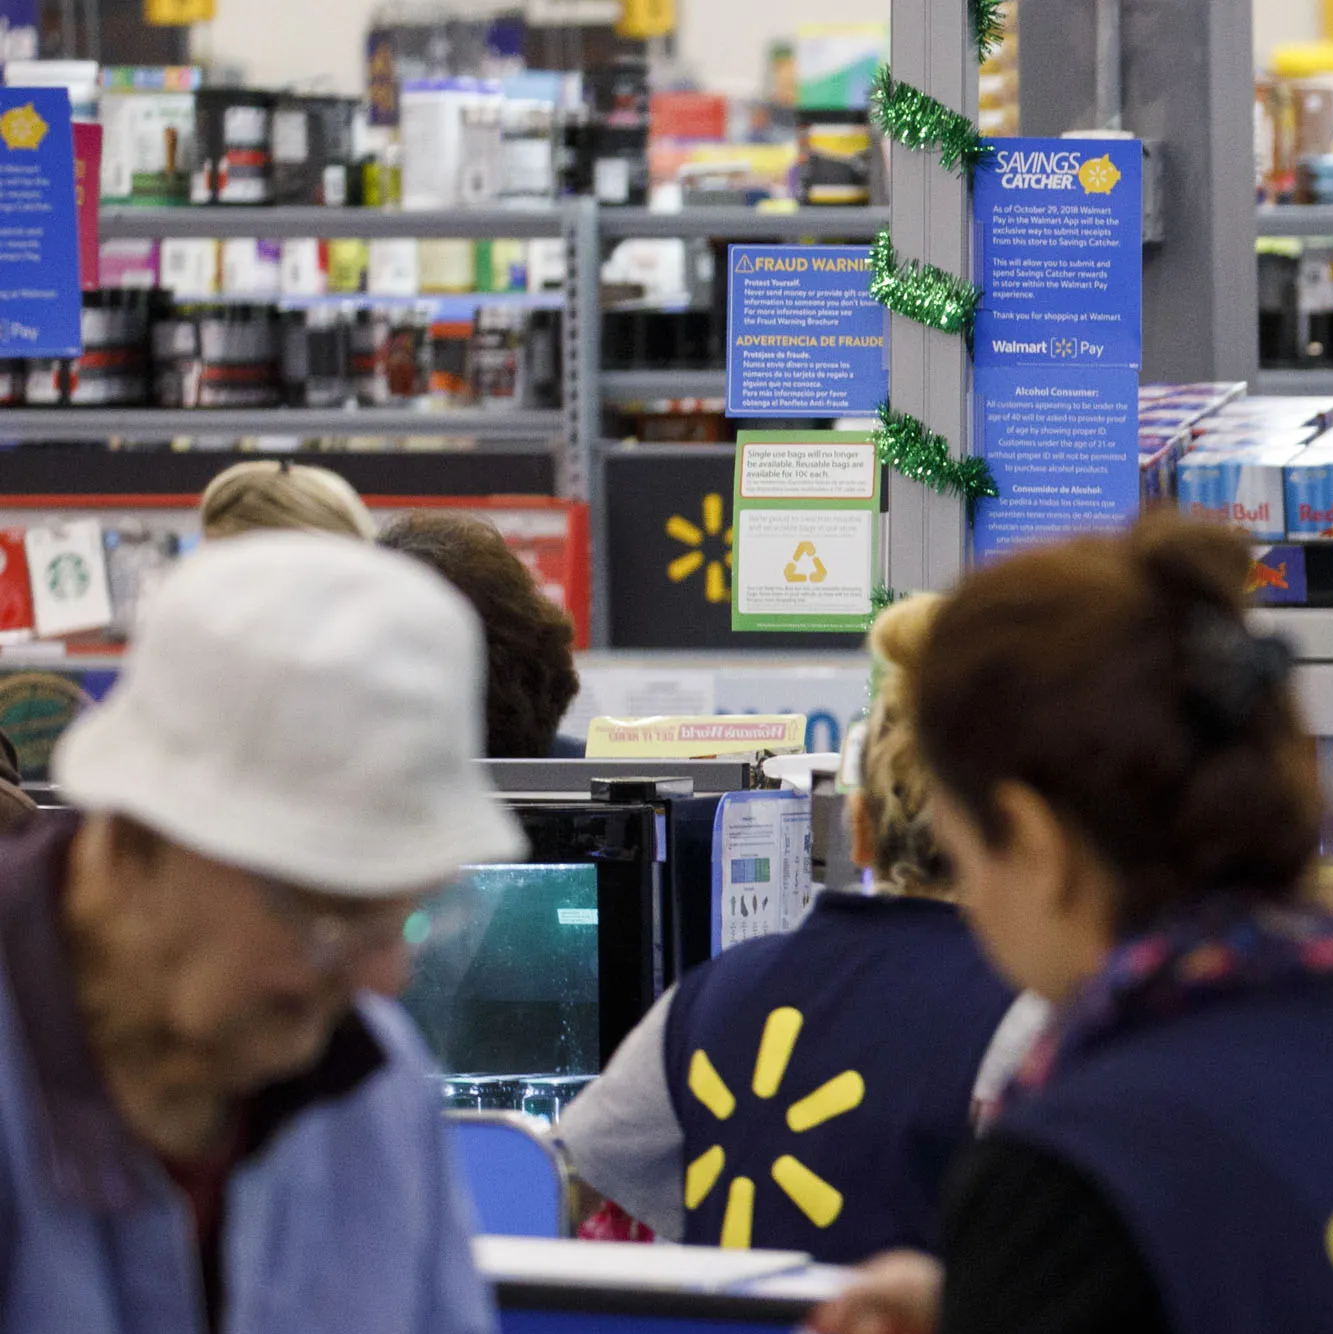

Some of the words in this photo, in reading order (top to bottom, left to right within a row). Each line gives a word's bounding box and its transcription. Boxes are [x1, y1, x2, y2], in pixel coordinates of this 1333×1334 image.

[995, 151, 1080, 174] SAVINGS
[1002, 174, 1073, 189] CATCHER
[993, 205, 1002, 213] As
[1004, 205, 1013, 213] of
[1014, 205, 1045, 213] October
[1048, 206, 1059, 215] 29,
[1080, 207, 1111, 215] Walmart
[993, 216, 1006, 225] Pay
[1008, 216, 1015, 224] in
[1017, 216, 1028, 224] the
[1031, 216, 1061, 224] Walmart
[1064, 217, 1078, 226] App
[1095, 217, 1104, 225] be
[1081, 228, 1111, 237] receipts
[1060, 239, 1086, 248] Savings
[756, 258, 808, 272] FRAUD
[812, 258, 872, 272] WARNI
[993, 258, 1007, 266] This
[1023, 259, 1042, 267] allow
[1044, 260, 1058, 269] you
[1097, 260, 1110, 268] and
[993, 270, 1014, 278] spend
[1017, 270, 1044, 278] Savings
[1046, 270, 1075, 278] Catcher
[1095, 282, 1108, 291] Pay
[778, 318, 806, 326] Warning
[1016, 313, 1029, 321] you
[1045, 312, 1078, 322] shopping
[1090, 313, 1121, 321] Walmart
[736, 336, 817, 346] ADVERTENCIA
[821, 336, 836, 346] DE
[839, 336, 884, 346] FRAUDE
[992, 340, 1047, 354] Walmart
[1081, 342, 1104, 358] Pay
[1016, 386, 1049, 396] Alcohol
[1051, 387, 1100, 397] Consumer:
[748, 450, 771, 459] Single
[788, 450, 806, 459] bags
[834, 450, 859, 459] longer
[832, 461, 850, 470] bags
[746, 470, 780, 478] available
[1233, 503, 1269, 521] Bull
